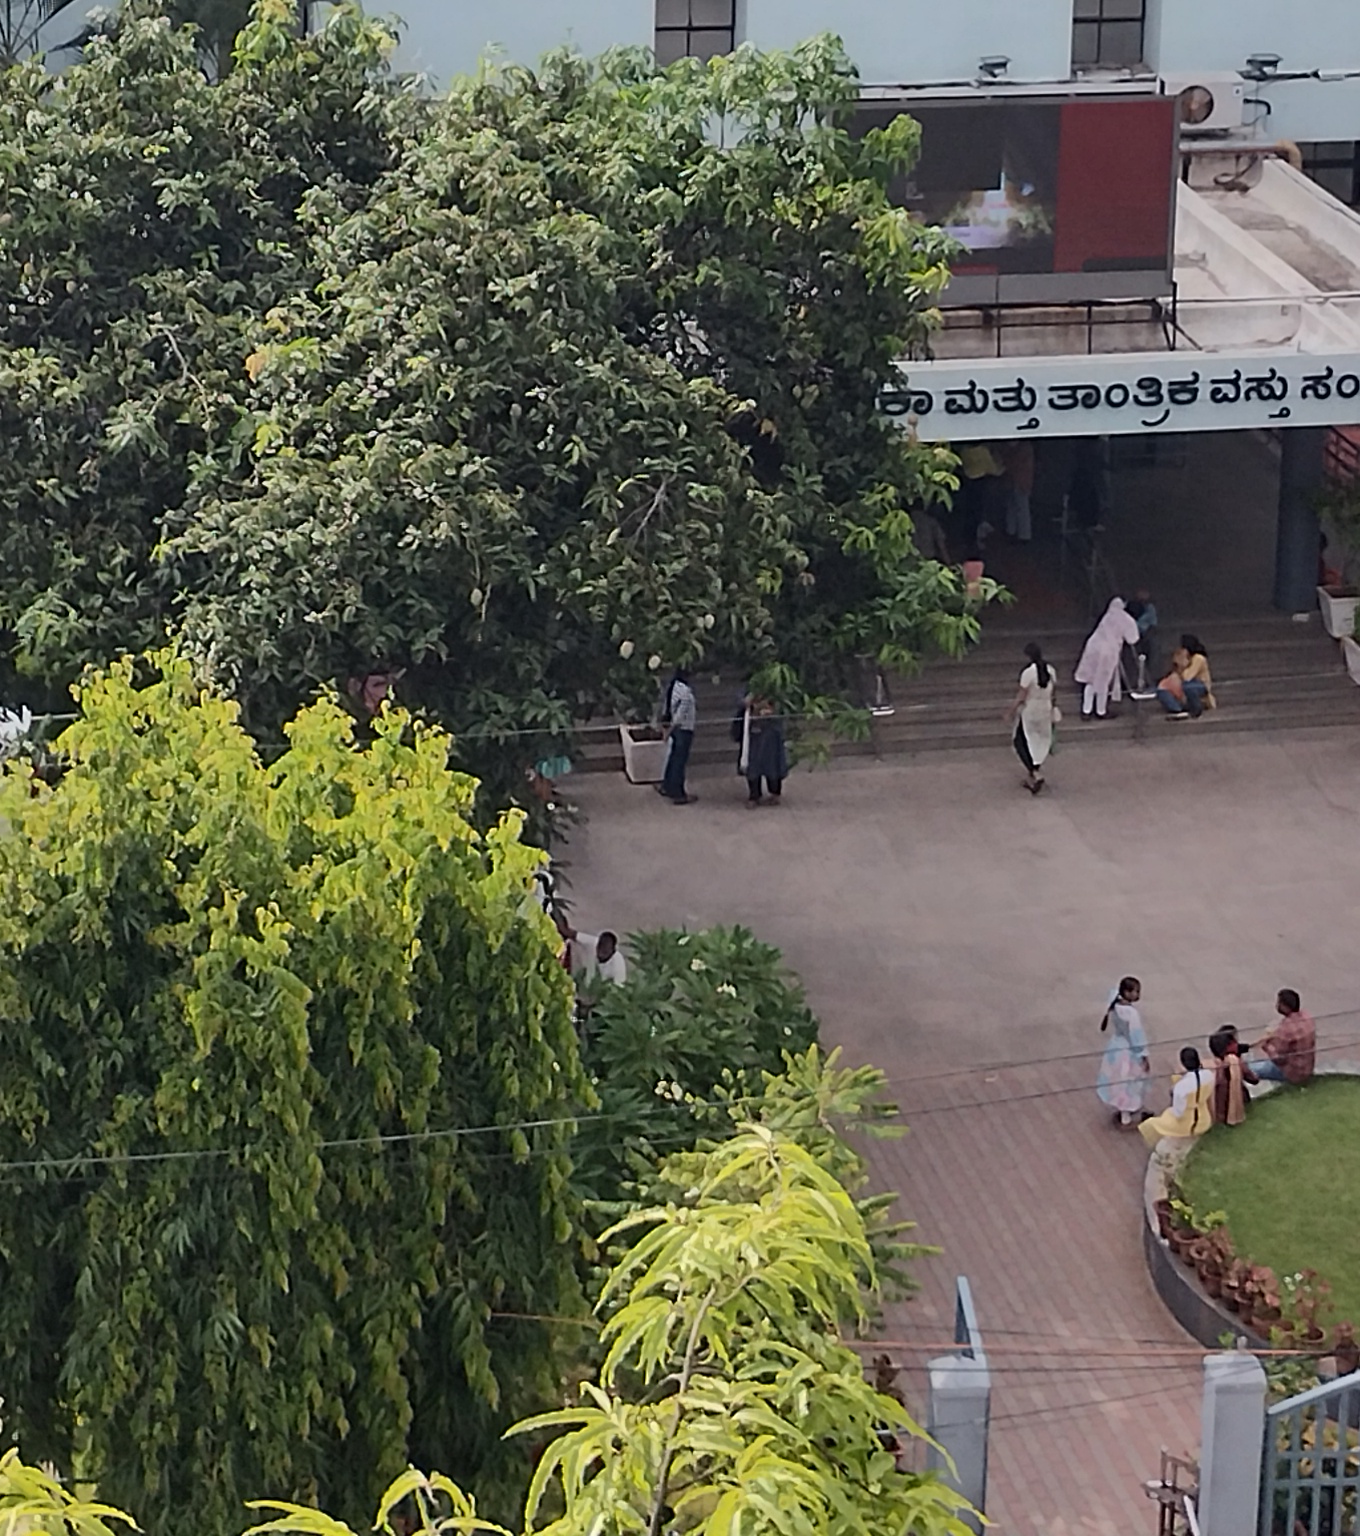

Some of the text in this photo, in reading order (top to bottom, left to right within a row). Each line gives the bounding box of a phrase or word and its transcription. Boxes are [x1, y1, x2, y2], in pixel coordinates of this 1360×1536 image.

[944, 377, 1040, 430] ಮತ್ತು
[1047, 371, 1200, 427] ತಾಂತ್ರಿಕ
[1210, 367, 1291, 419] ವಸ್ತು
